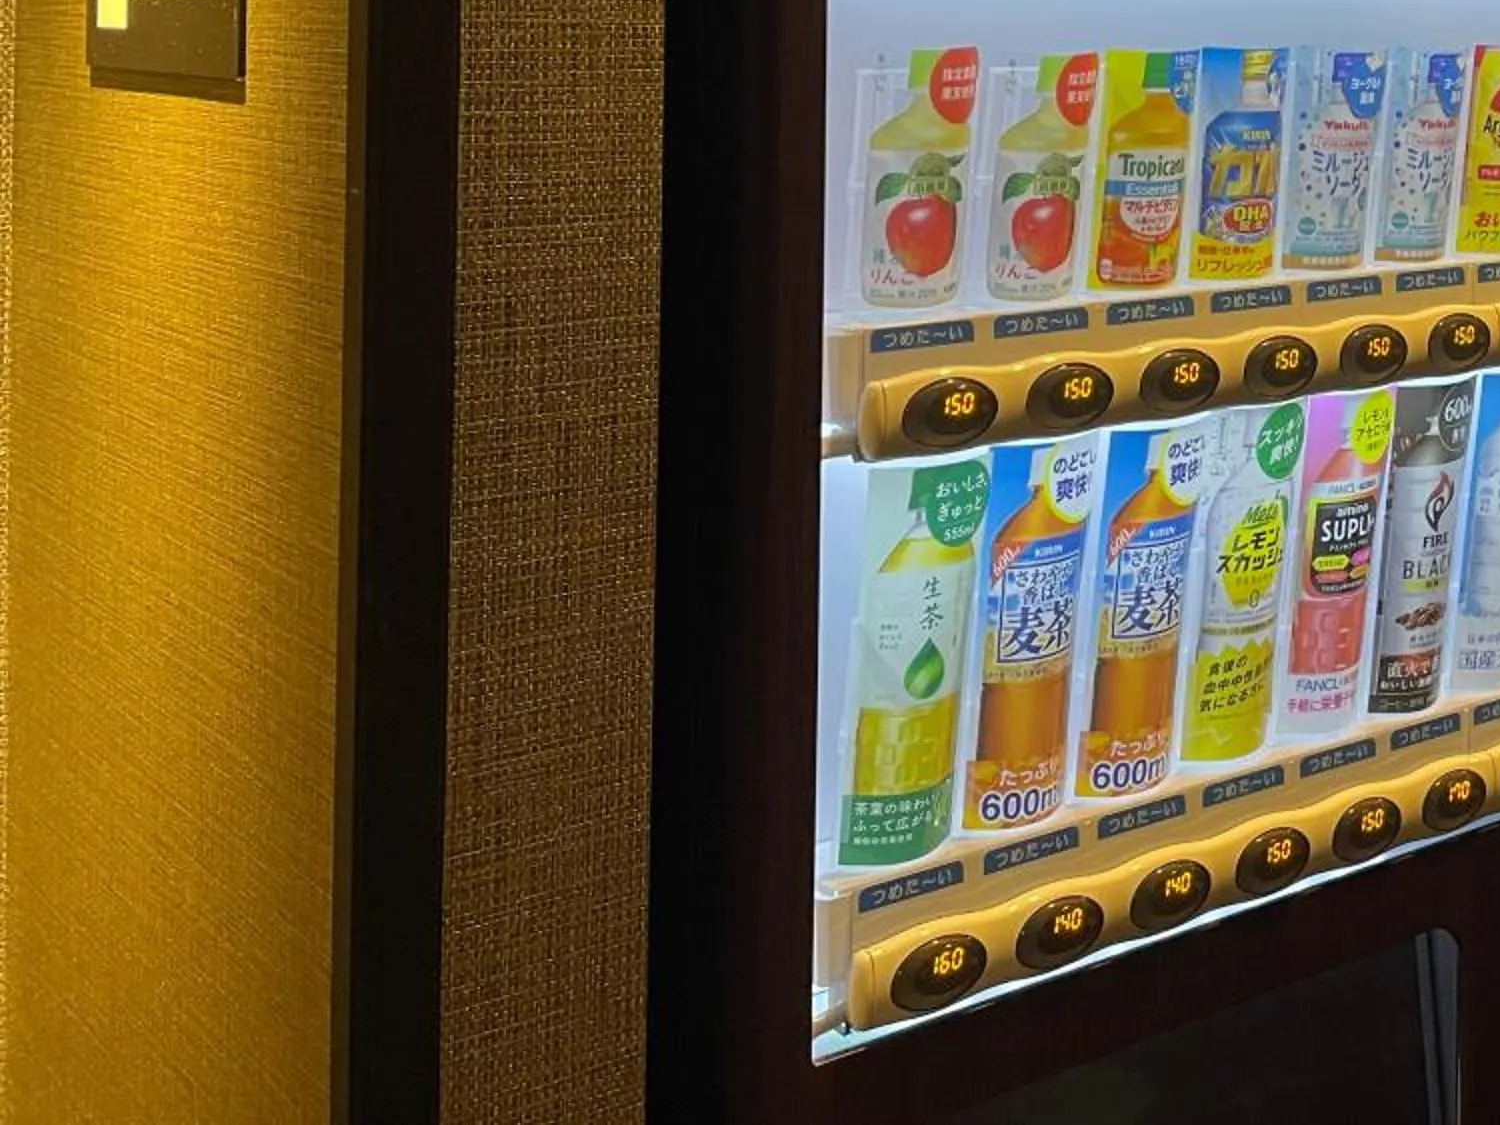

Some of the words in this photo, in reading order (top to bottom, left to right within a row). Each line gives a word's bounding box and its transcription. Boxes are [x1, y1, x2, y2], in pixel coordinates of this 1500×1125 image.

[1368, 336, 1391, 357] 150
[1453, 325, 1476, 345] 150
[1275, 348, 1300, 370] 150
[1175, 362, 1201, 384] 150
[1064, 376, 1094, 400] 150
[943, 392, 975, 417] 150
[937, 494, 984, 523] ぎゅっと
[1231, 527, 1282, 553] レモン
[1422, 531, 1450, 549] FIRE
[918, 575, 945, 633] 生茶
[1117, 578, 1182, 634] 麦茶
[1001, 596, 1074, 658] 麦茶
[1361, 808, 1385, 832] 150
[1267, 838, 1292, 864] 150
[1165, 870, 1192, 897] 140
[1054, 907, 1083, 935] 140
[933, 947, 965, 975] 160
